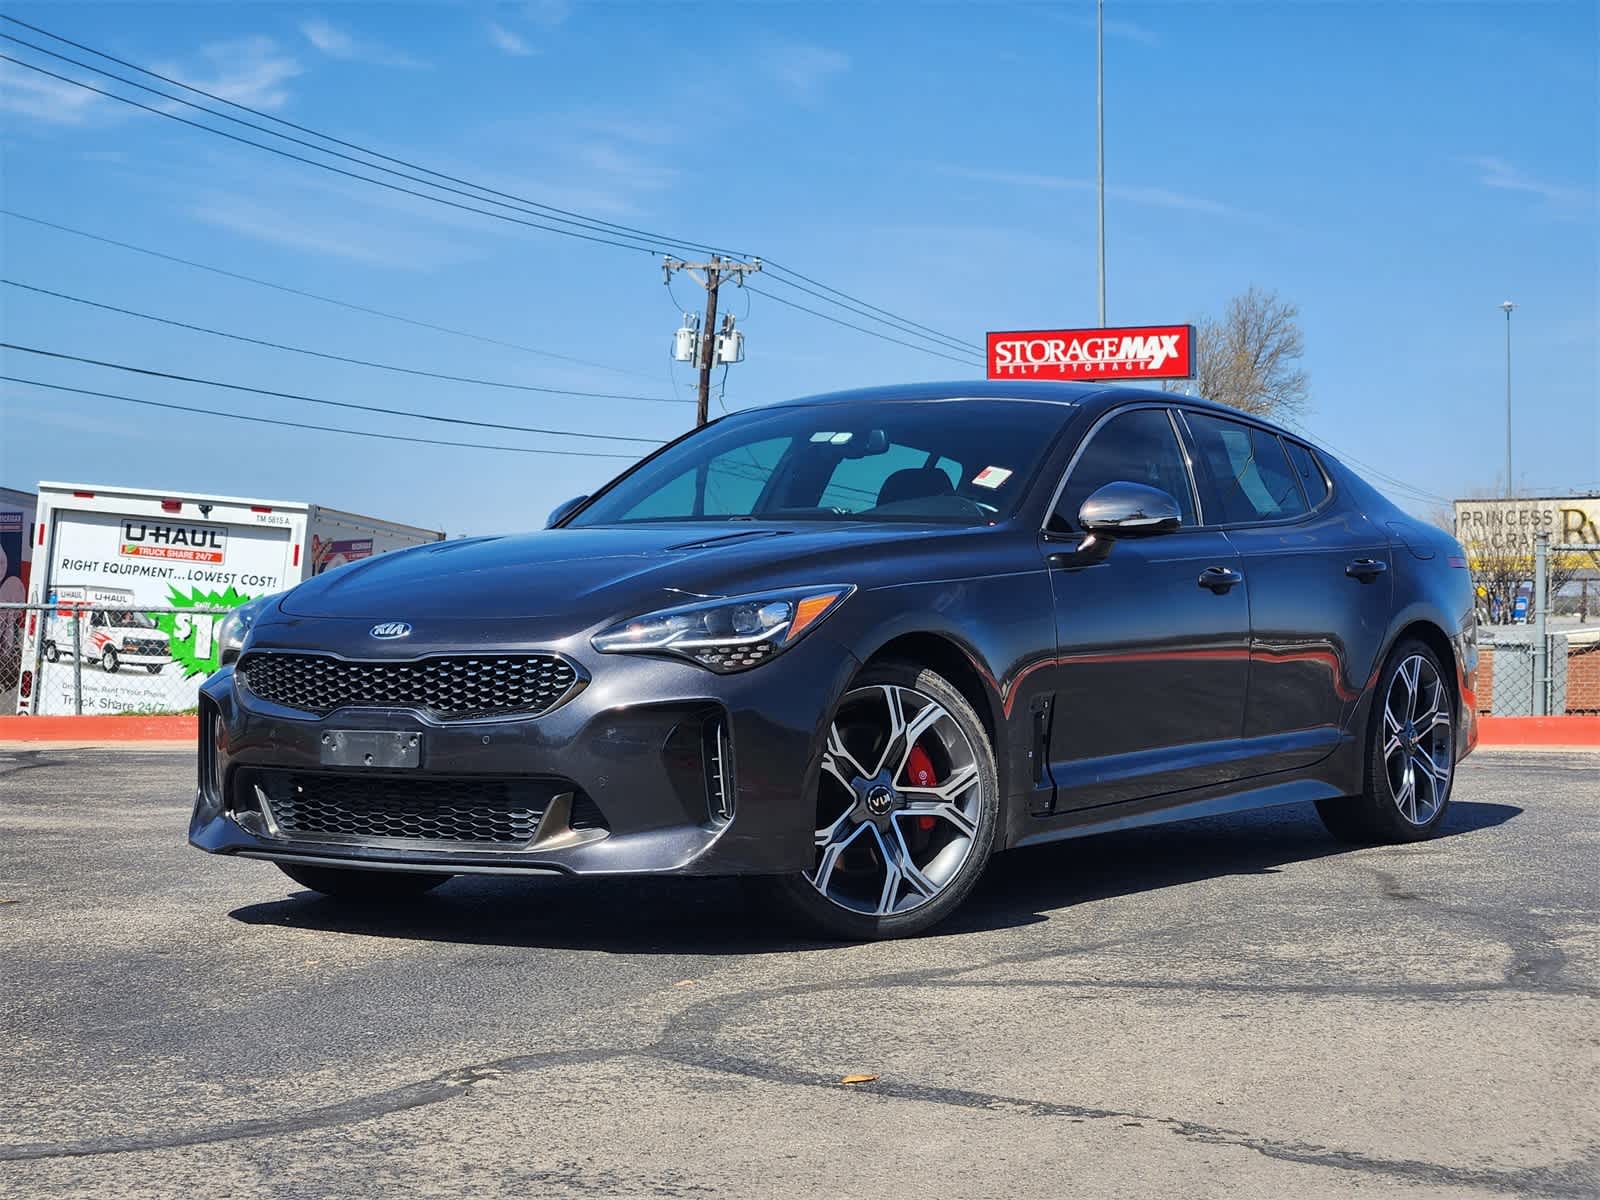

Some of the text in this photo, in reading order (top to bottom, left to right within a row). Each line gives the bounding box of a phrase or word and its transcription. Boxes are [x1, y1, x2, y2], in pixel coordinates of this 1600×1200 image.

[995, 361, 1146, 374] SELF STORAGE
[1460, 510, 1553, 527] PRINCESS
[125, 523, 223, 549] U-HAUL
[138, 547, 214, 561] TRUCK SHARE 24/7
[61, 558, 100, 572] RIGHT
[241, 575, 278, 588] COST!
[94, 593, 128, 603] U-HAUL
[373, 623, 407, 636] KIA
[62, 694, 95, 708] Trck
[99, 697, 135, 711] Share
